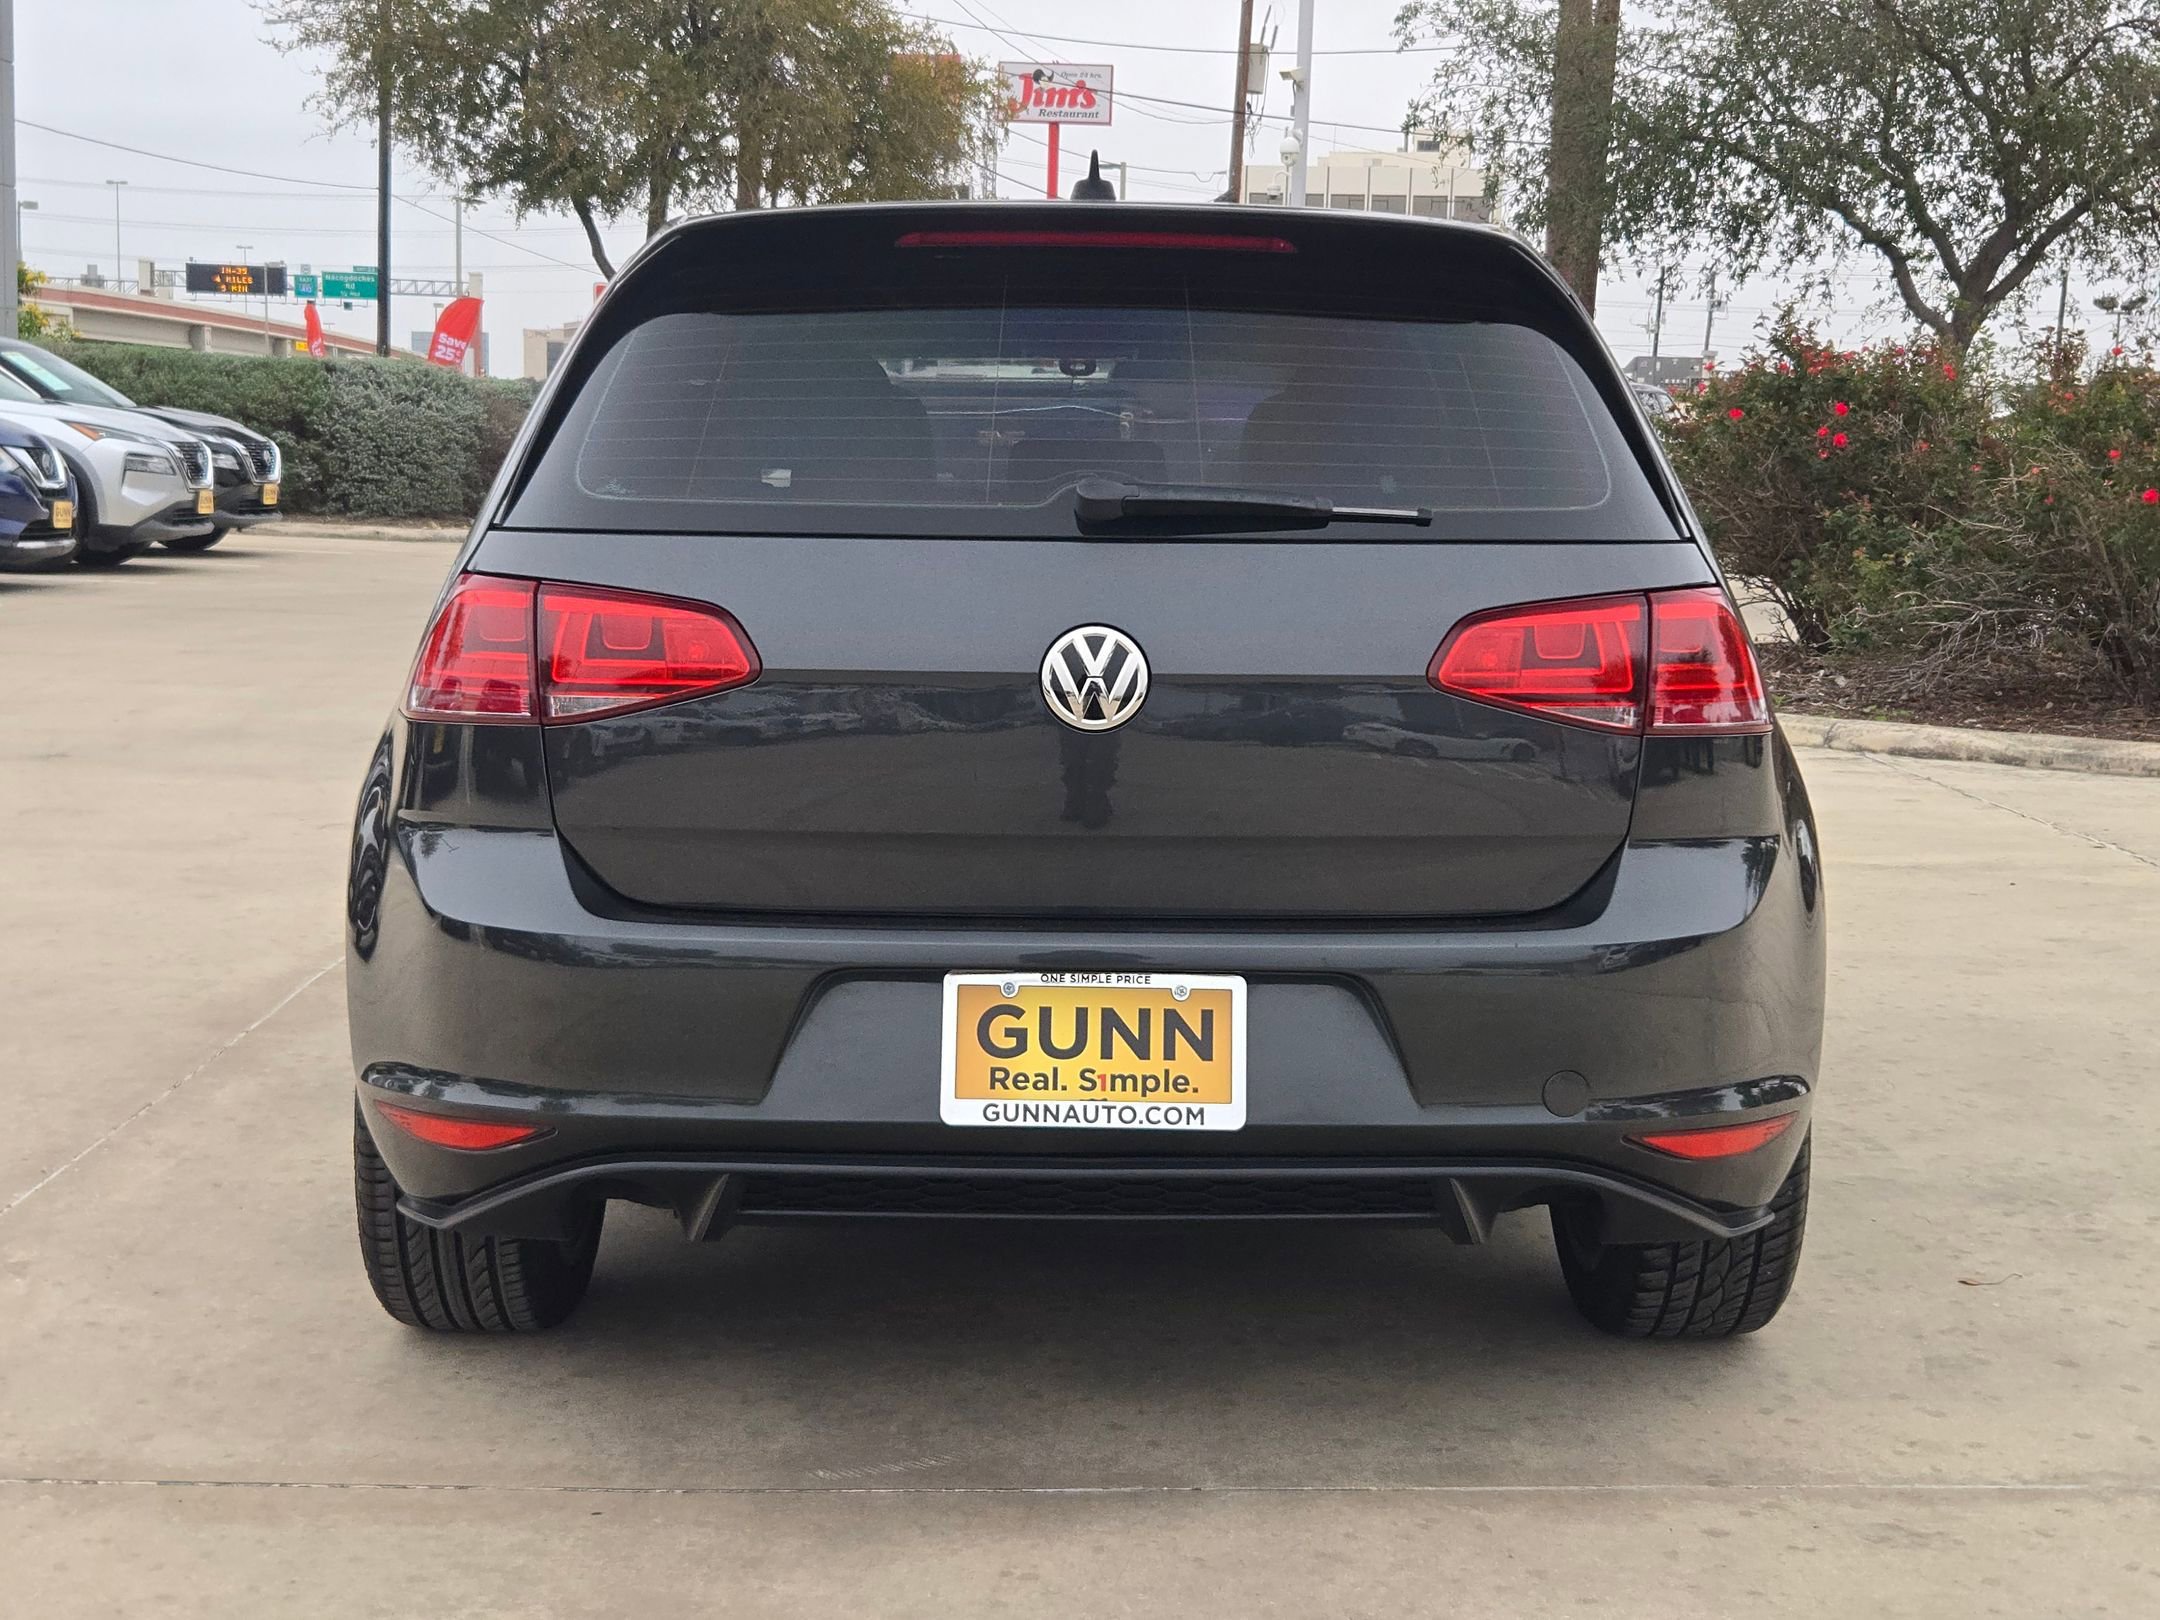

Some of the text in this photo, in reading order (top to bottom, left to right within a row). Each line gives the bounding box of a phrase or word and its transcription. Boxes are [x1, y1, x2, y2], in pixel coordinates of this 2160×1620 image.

[1010, 73, 1097, 111] Jim's
[1038, 109, 1100, 118] Restaurant
[226, 276, 254, 284] MILES
[325, 274, 375, 283] Nacogdoches
[1041, 973, 1151, 985] ONE SIMPLE PRICE
[977, 1003, 1214, 1062] GUNN
[989, 1066, 1068, 1092] Real.
[983, 1103, 1205, 1126] GUNNAUTO.COM
